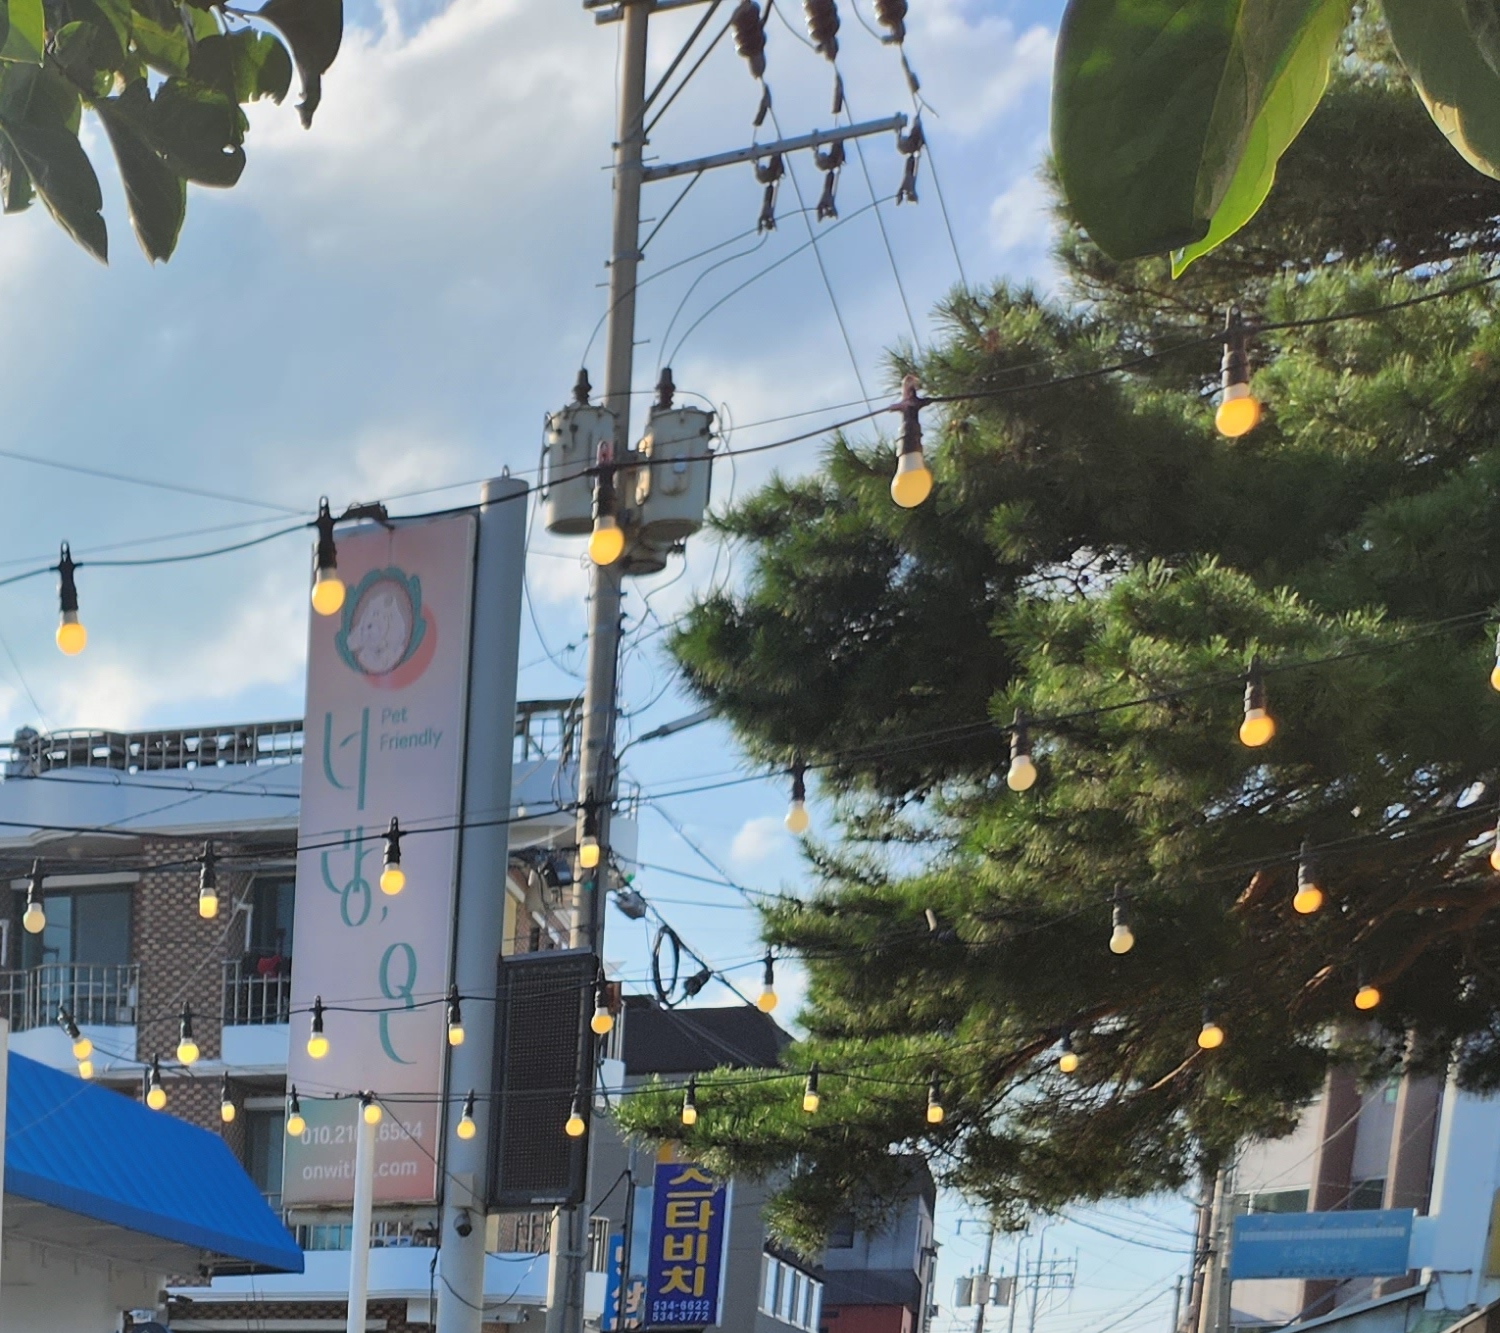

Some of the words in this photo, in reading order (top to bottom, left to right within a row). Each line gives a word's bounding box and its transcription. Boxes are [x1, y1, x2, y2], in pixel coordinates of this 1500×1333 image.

[381, 706, 408, 724] Pet
[380, 727, 443, 751] Friendly
[301, 1121, 423, 1145] 010.21.6584
[659, 1167, 715, 1297] 스타비치
[652, 1311, 709, 1321] 534-3772
[653, 1300, 710, 1311] 534-6622
